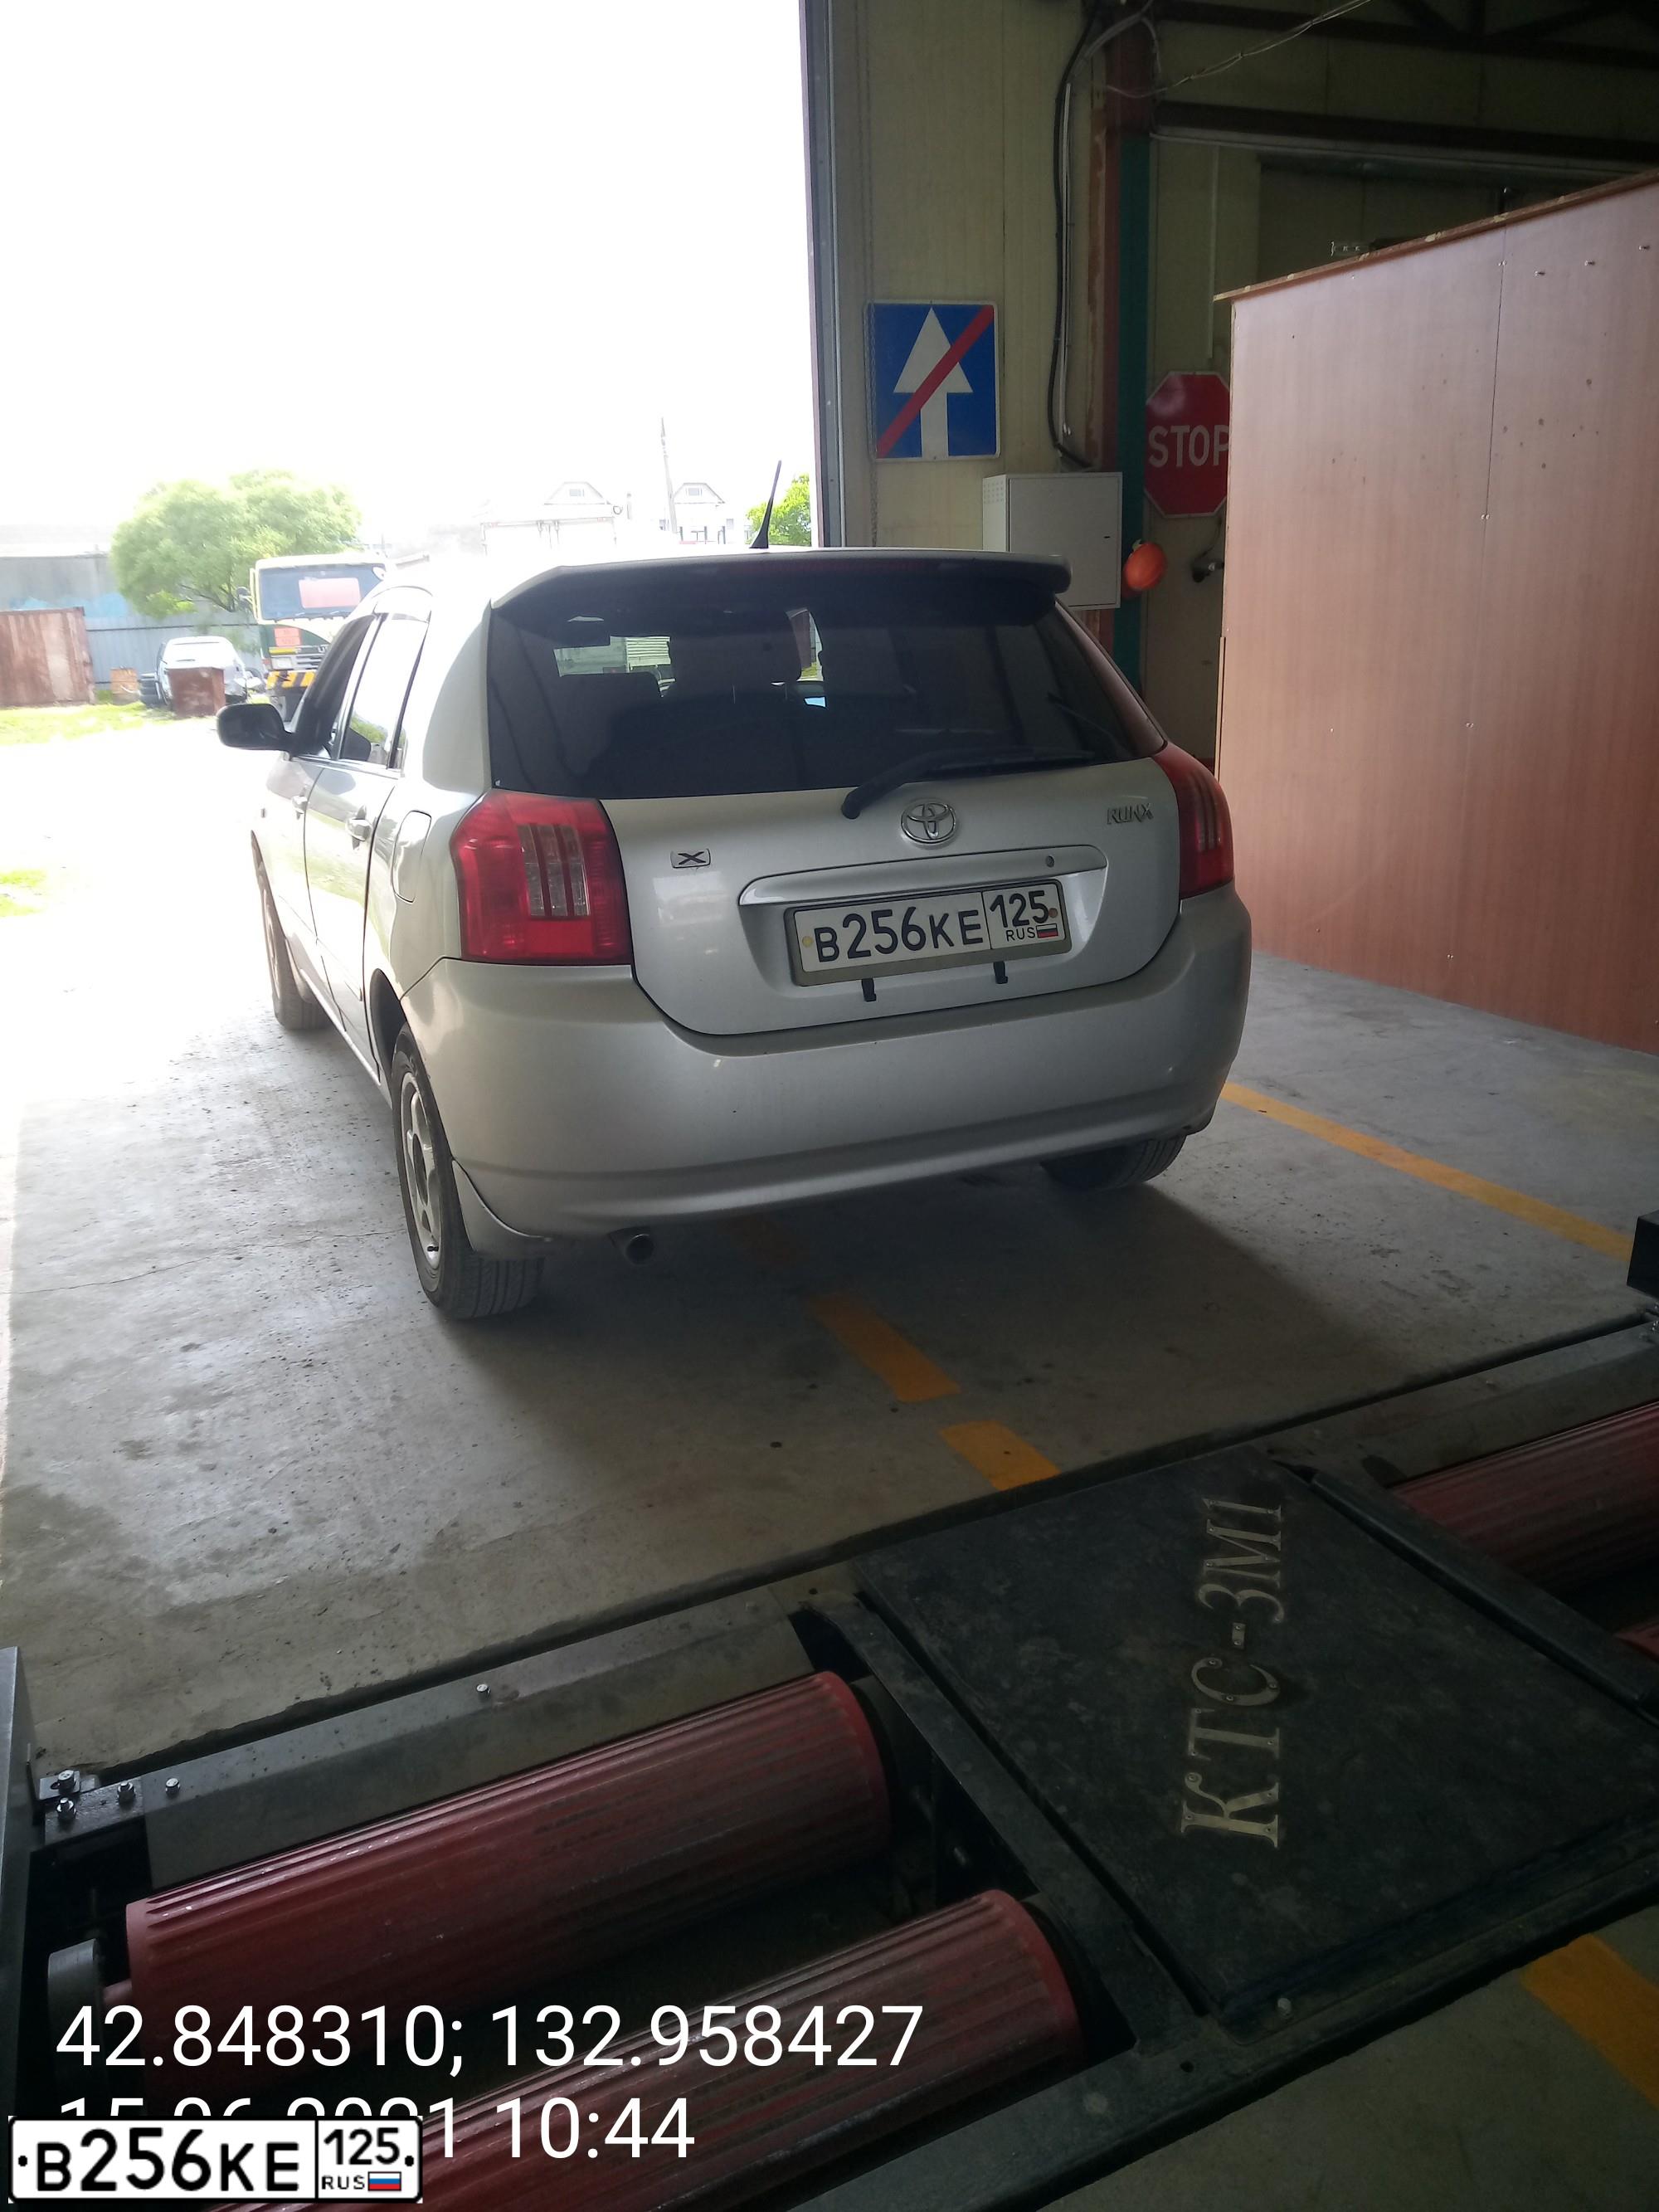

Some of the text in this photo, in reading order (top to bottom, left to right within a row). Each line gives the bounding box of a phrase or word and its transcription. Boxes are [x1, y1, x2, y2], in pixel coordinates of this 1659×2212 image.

[1148, 424, 1229, 468] STOP
[1106, 802, 1154, 826] RUNX
[813, 889, 1049, 962] В256КЕ 125
[1005, 926, 1036, 942] RUS
